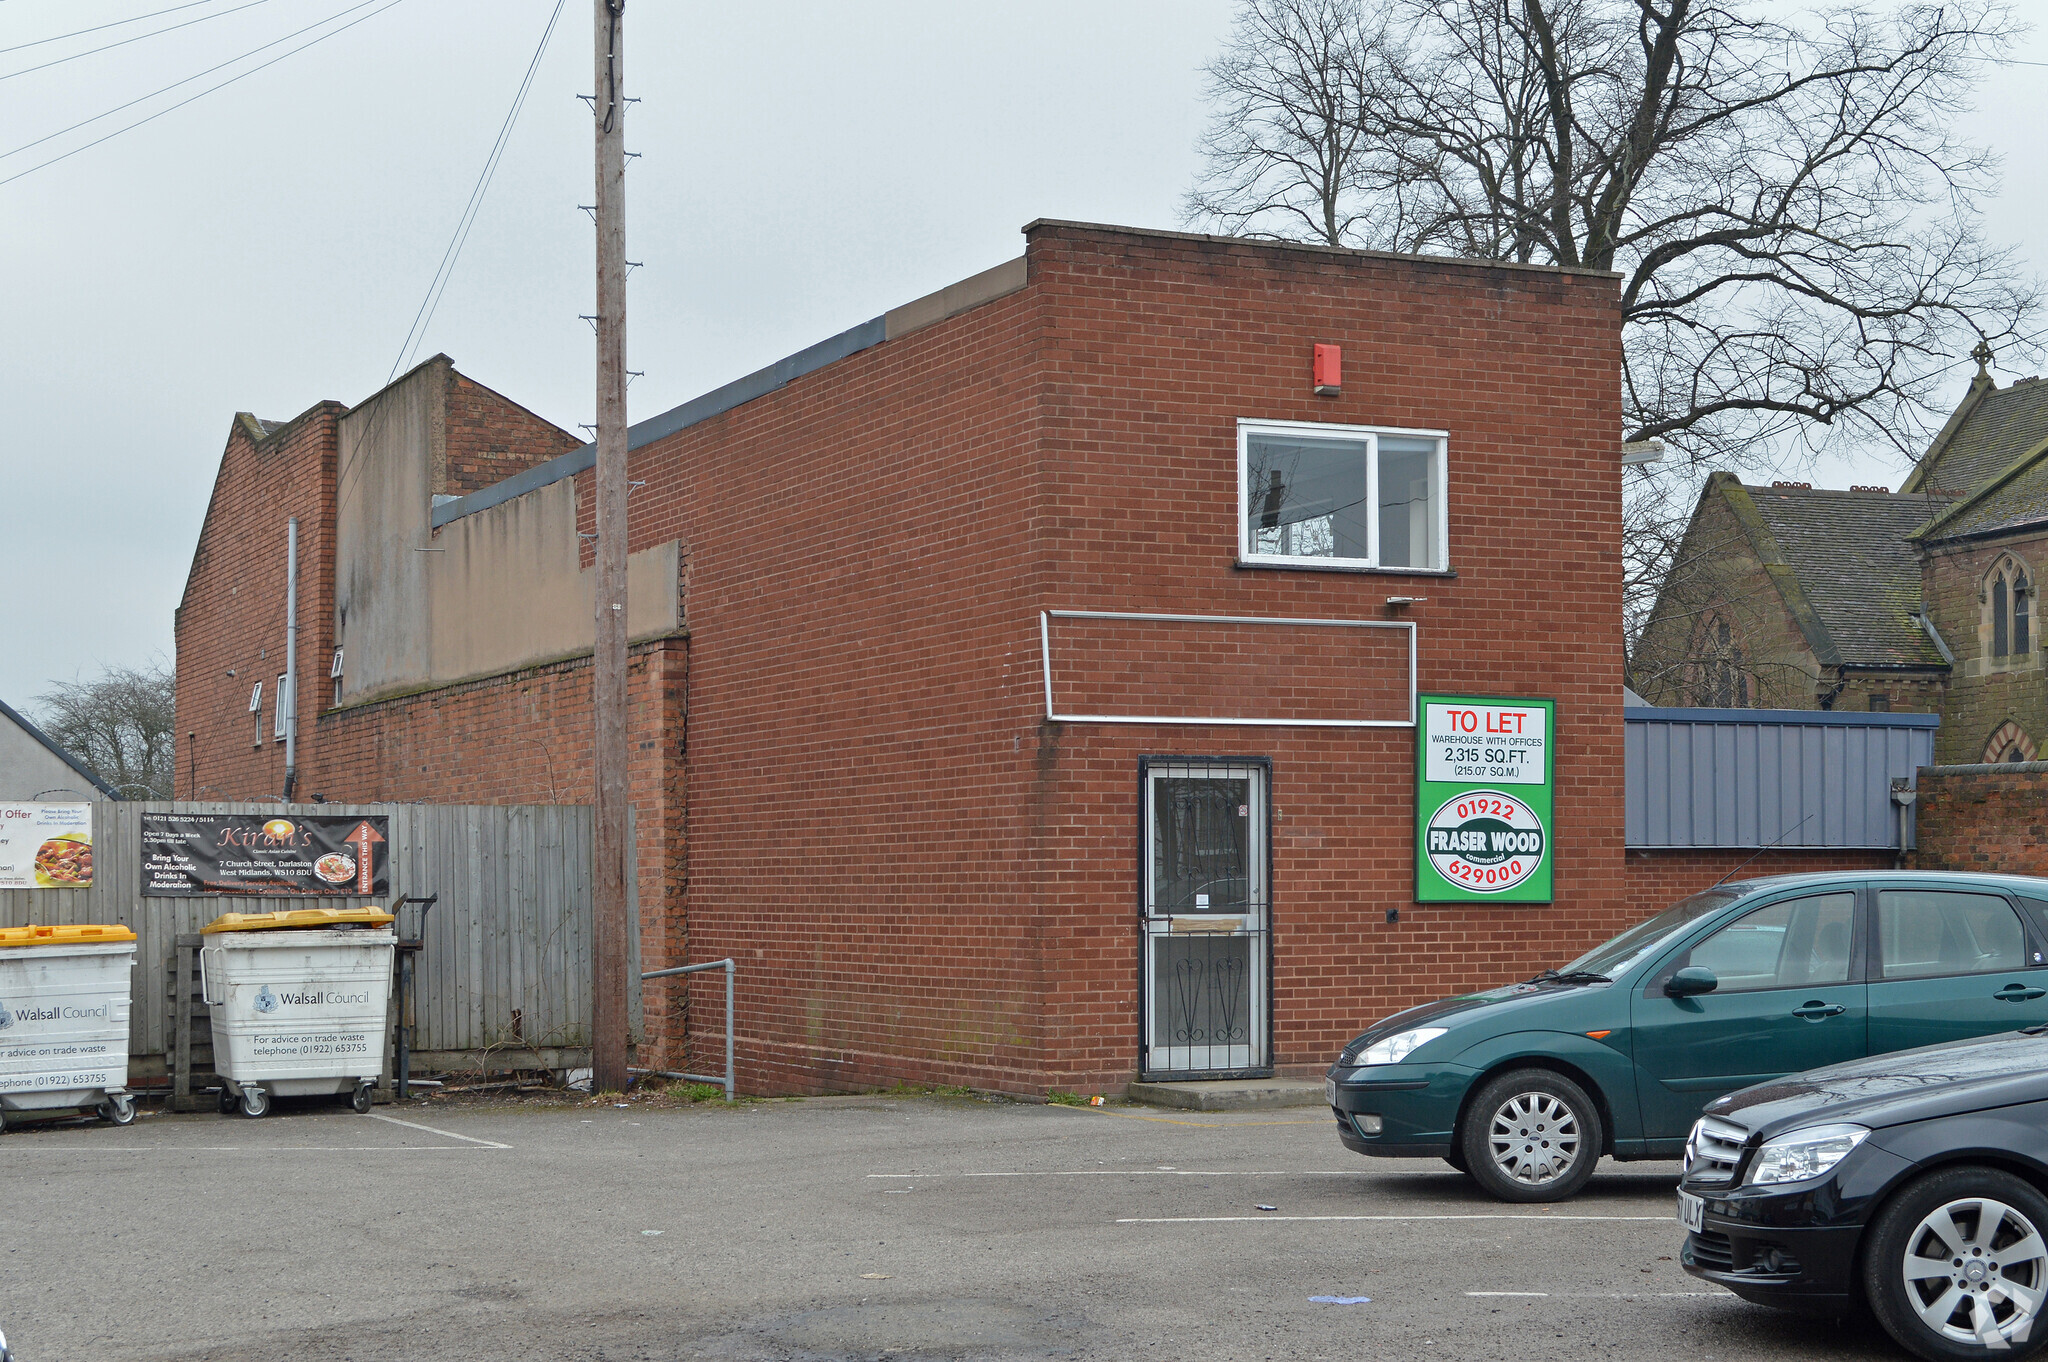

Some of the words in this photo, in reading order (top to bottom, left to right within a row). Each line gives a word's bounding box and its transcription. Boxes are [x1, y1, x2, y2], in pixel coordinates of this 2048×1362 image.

[1447, 711, 1477, 733] TO
[1486, 712, 1527, 734] LET
[1432, 735, 1483, 745] WAREHOUSE
[1486, 737, 1506, 746] WITH
[1509, 738, 1542, 747] OFFICES
[1445, 748, 1479, 764] 2,315
[1485, 749, 1530, 764] SQ.FT.
[1455, 764, 1486, 776] (215.07
[1490, 767, 1520, 777] SQ.M.)
[5, 810, 32, 819] Offer
[1457, 799, 1515, 820] 01922
[1430, 831, 1487, 852] FRASER
[1491, 832, 1540, 852] WOOD
[152, 854, 171, 862] Bring
[253, 860, 277, 868] Street,
[1465, 853, 1505, 864] commercial
[164, 863, 197, 871] Alcoholic
[1449, 860, 1522, 884] 629000
[154, 872, 178, 880] Drinks
[361, 857, 369, 893] ENTRANCE
[149, 881, 192, 889] Moderation
[280, 991, 323, 1005] Walsall
[325, 990, 369, 1004] Council
[16, 1007, 60, 1021] Walsall
[62, 1004, 107, 1019] Council
[253, 1035, 270, 1044] For
[271, 1034, 299, 1044] advice
[301, 1034, 313, 1043] on
[314, 1033, 338, 1043] trade
[339, 1033, 365, 1042] waste
[7, 1048, 37, 1058] advice
[38, 1048, 51, 1056] on
[53, 1045, 78, 1055] trade
[80, 1045, 107, 1053] waste
[253, 1046, 298, 1057] telephone
[299, 1044, 333, 1055] (01922)
[335, 1043, 367, 1053] 653755
[35, 1076, 71, 1088] (01922)
[72, 1073, 107, 1084] 653755
